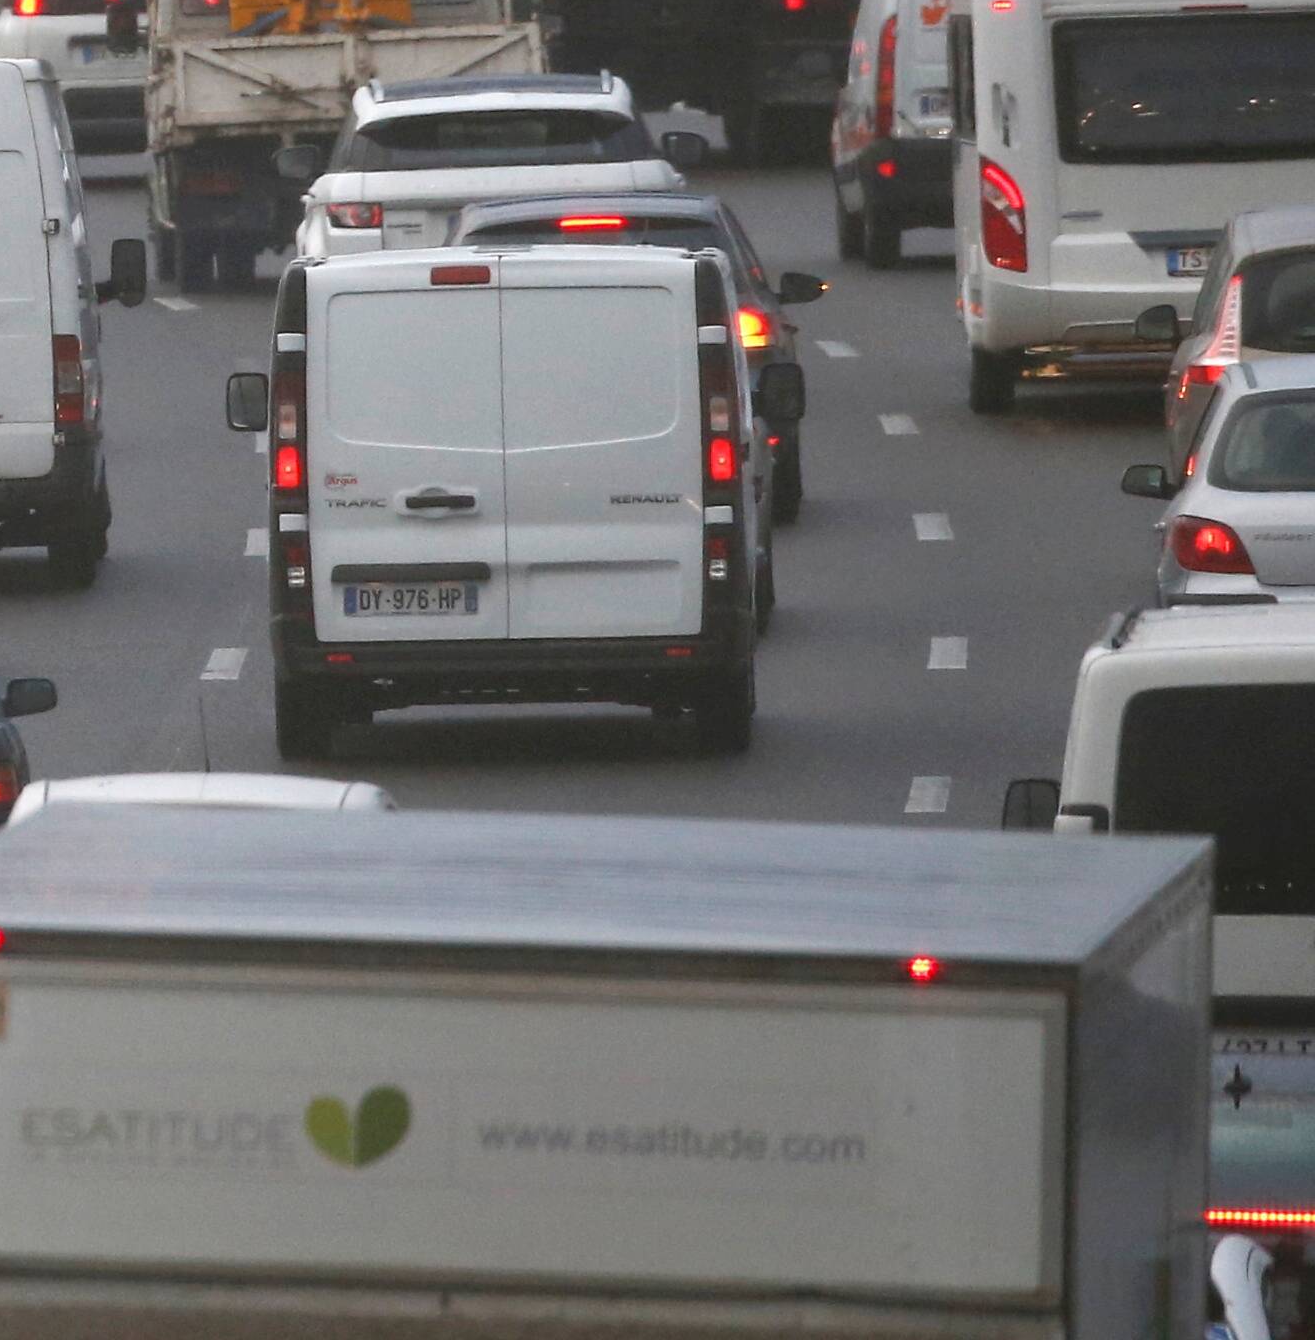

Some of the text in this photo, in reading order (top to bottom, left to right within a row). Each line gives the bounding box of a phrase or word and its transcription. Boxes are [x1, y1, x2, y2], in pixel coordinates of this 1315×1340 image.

[610, 493, 683, 504] RENAULT
[359, 587, 462, 610] DY-976-HP
[21, 1107, 868, 1162] ESATITUDE www.esatitude.com
